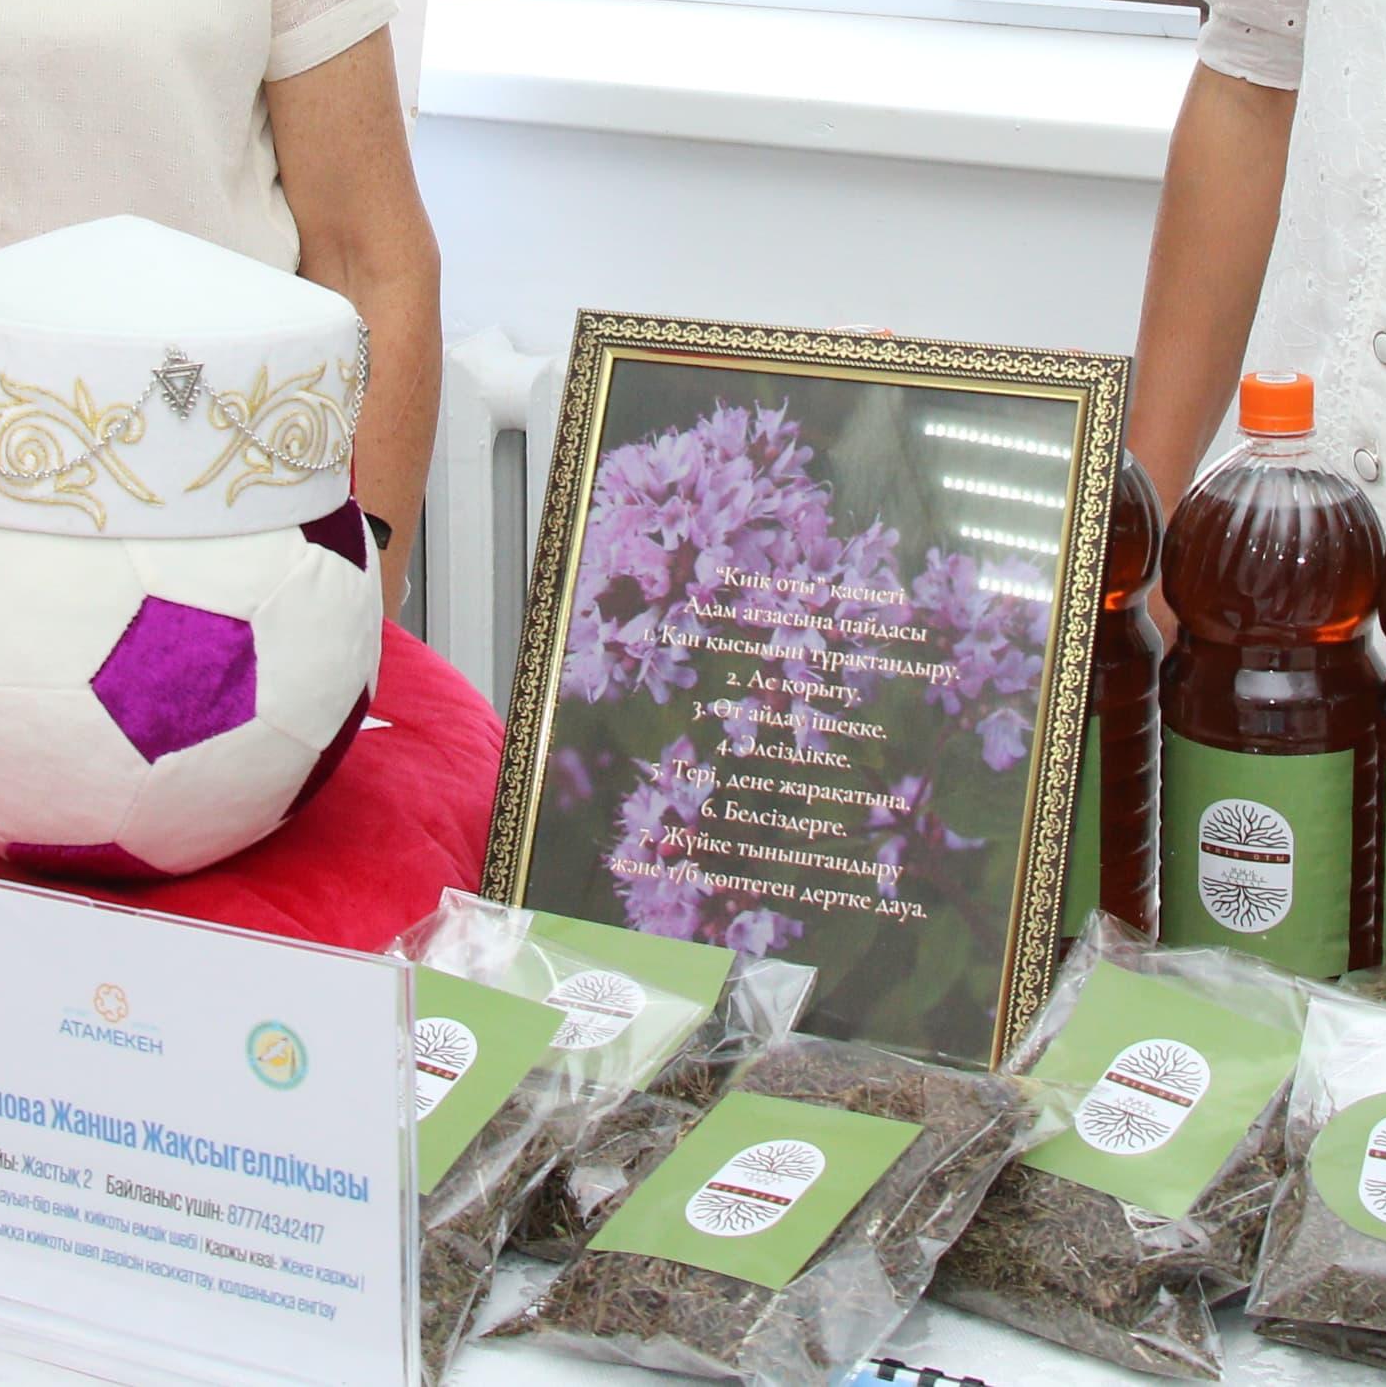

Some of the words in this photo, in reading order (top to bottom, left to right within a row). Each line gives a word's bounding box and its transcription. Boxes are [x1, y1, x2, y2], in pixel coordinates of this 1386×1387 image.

[683, 595, 738, 620] Адам
[839, 615, 929, 643] пайдасы
[725, 673, 743, 688] 2.
[746, 669, 778, 692] Ас
[692, 700, 708, 721] 3.
[811, 714, 889, 741] ішекке.
[715, 738, 733, 757] 4.
[724, 773, 775, 793] дене
[700, 796, 719, 820] 6.
[723, 798, 849, 840] Белсіздерге.
[659, 824, 733, 856] Жүйке
[736, 842, 904, 887] тыныштандыру
[702, 869, 796, 900] көптеген
[799, 884, 872, 912] дертке
[875, 898, 929, 925] дауа.
[58, 1017, 165, 1057] АТАМЕКЕН
[49, 1097, 138, 1150] Жанша
[141, 1118, 371, 1204] Жақсыгелдіқызы
[82, 1167, 93, 1190] 2
[105, 1173, 183, 1213] Байланыс
[226, 1203, 326, 1246] 87774342417
